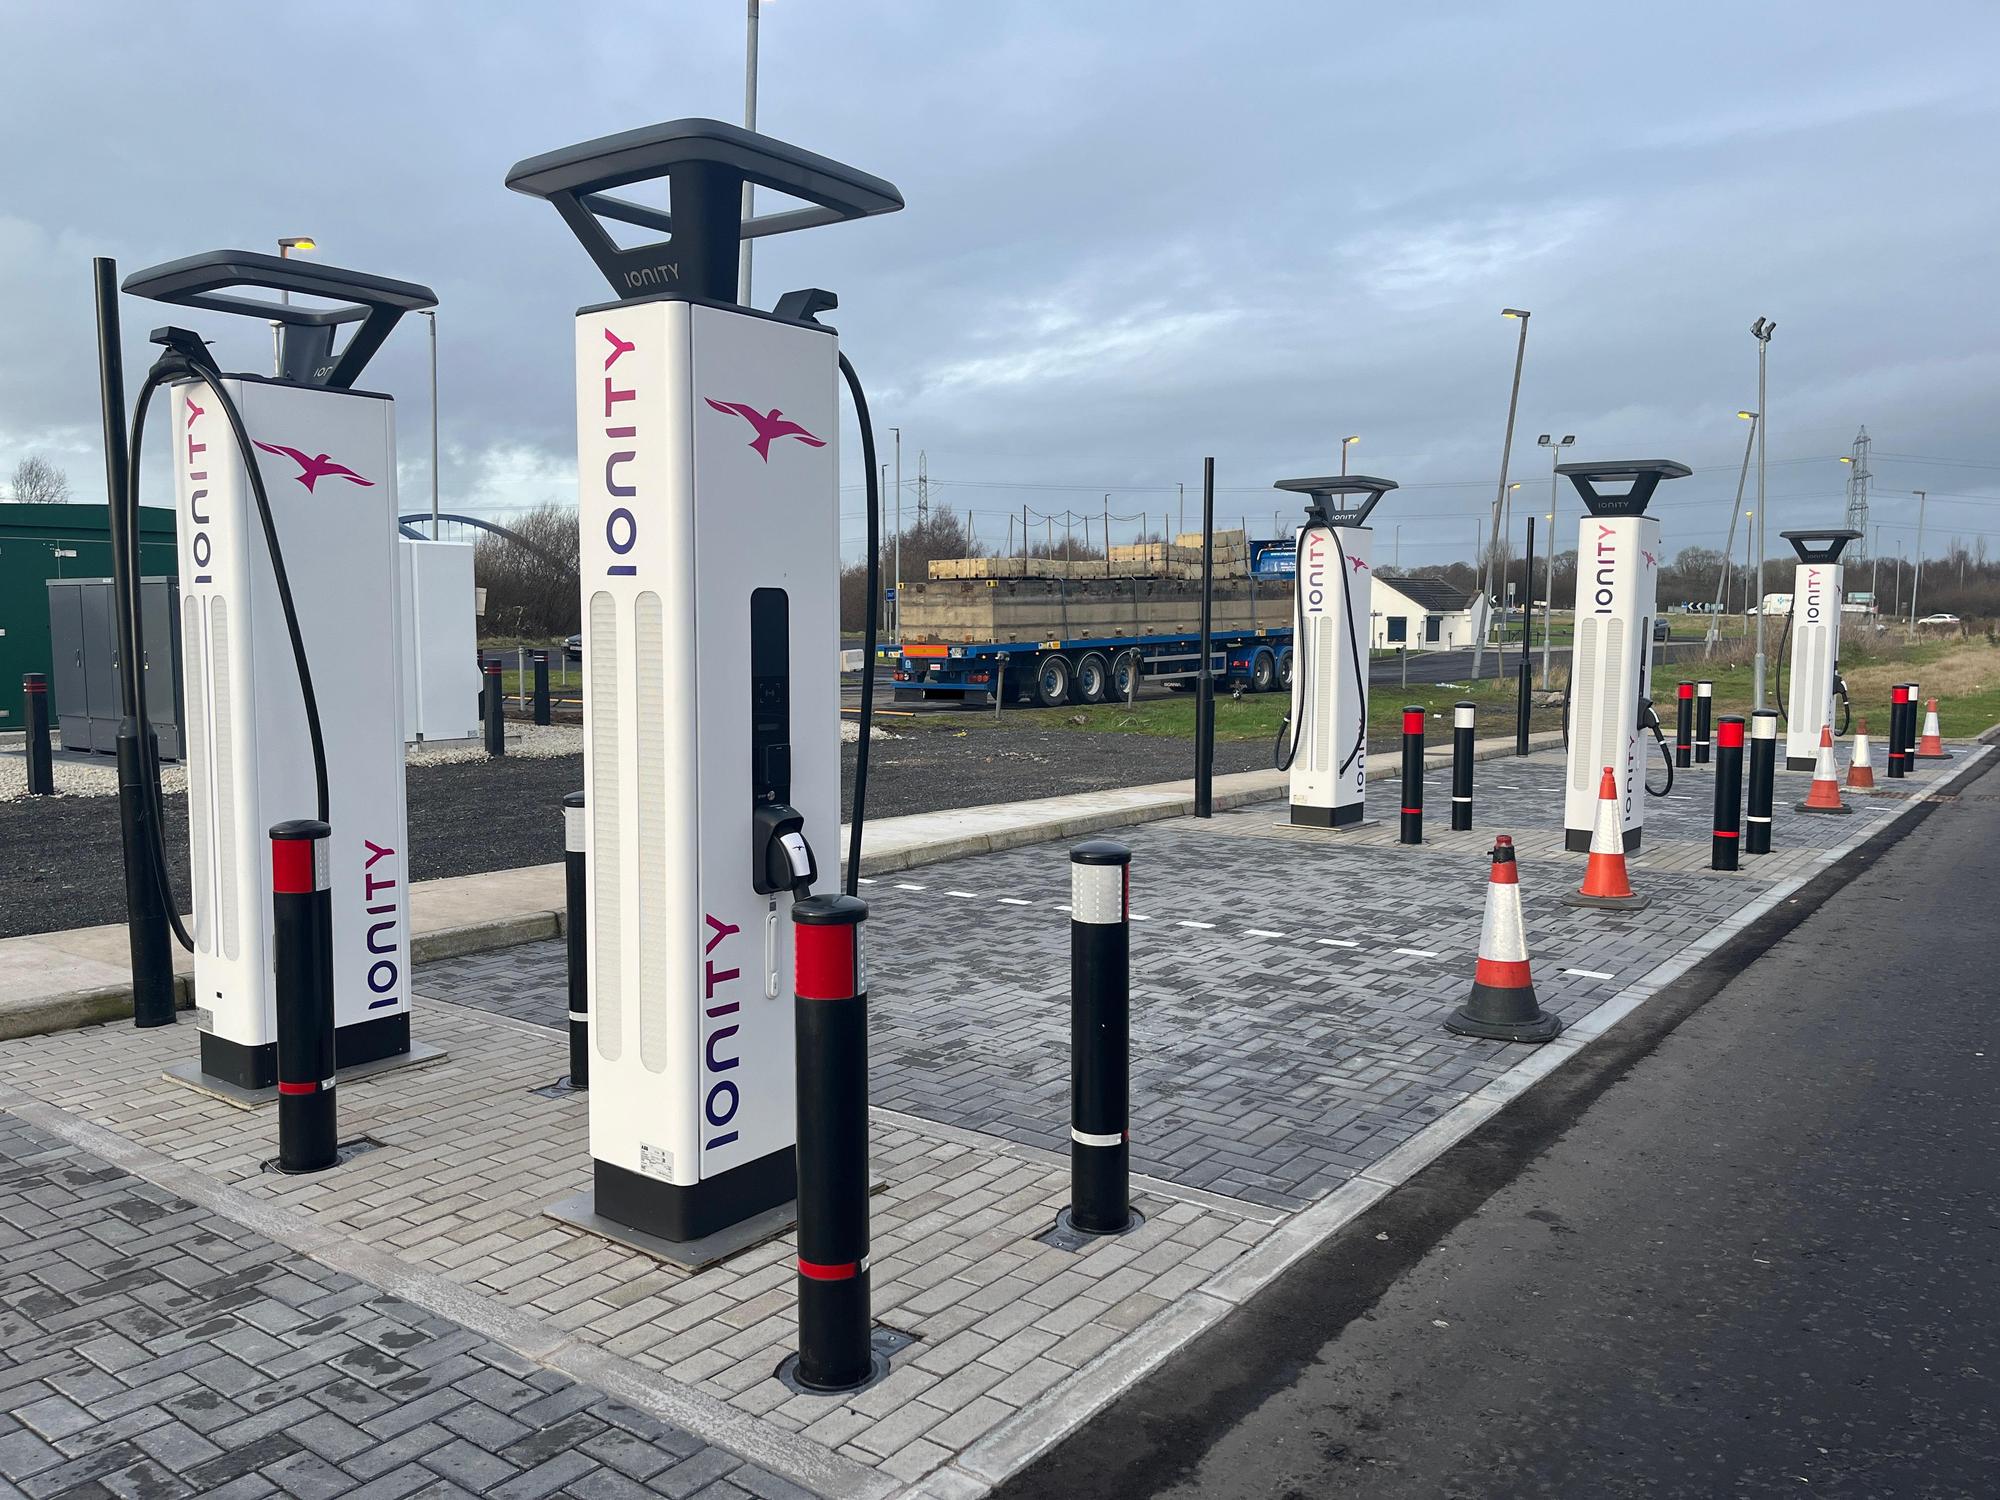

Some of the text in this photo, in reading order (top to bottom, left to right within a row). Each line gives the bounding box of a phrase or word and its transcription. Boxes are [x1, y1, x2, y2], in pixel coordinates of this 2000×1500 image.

[624, 263, 680, 289] IONITY
[186, 397, 212, 584] IONITY
[605, 327, 638, 577] IONITY
[1331, 513, 1357, 521] IONITY
[1598, 501, 1629, 509] IONITY
[1309, 532, 1326, 613] IONITY
[1595, 525, 1617, 614] IONITY
[1807, 568, 1821, 624] IONITY
[1624, 735, 1635, 821] IONITY
[364, 839, 399, 1011] IONITY
[705, 912, 740, 1151] IONITY
